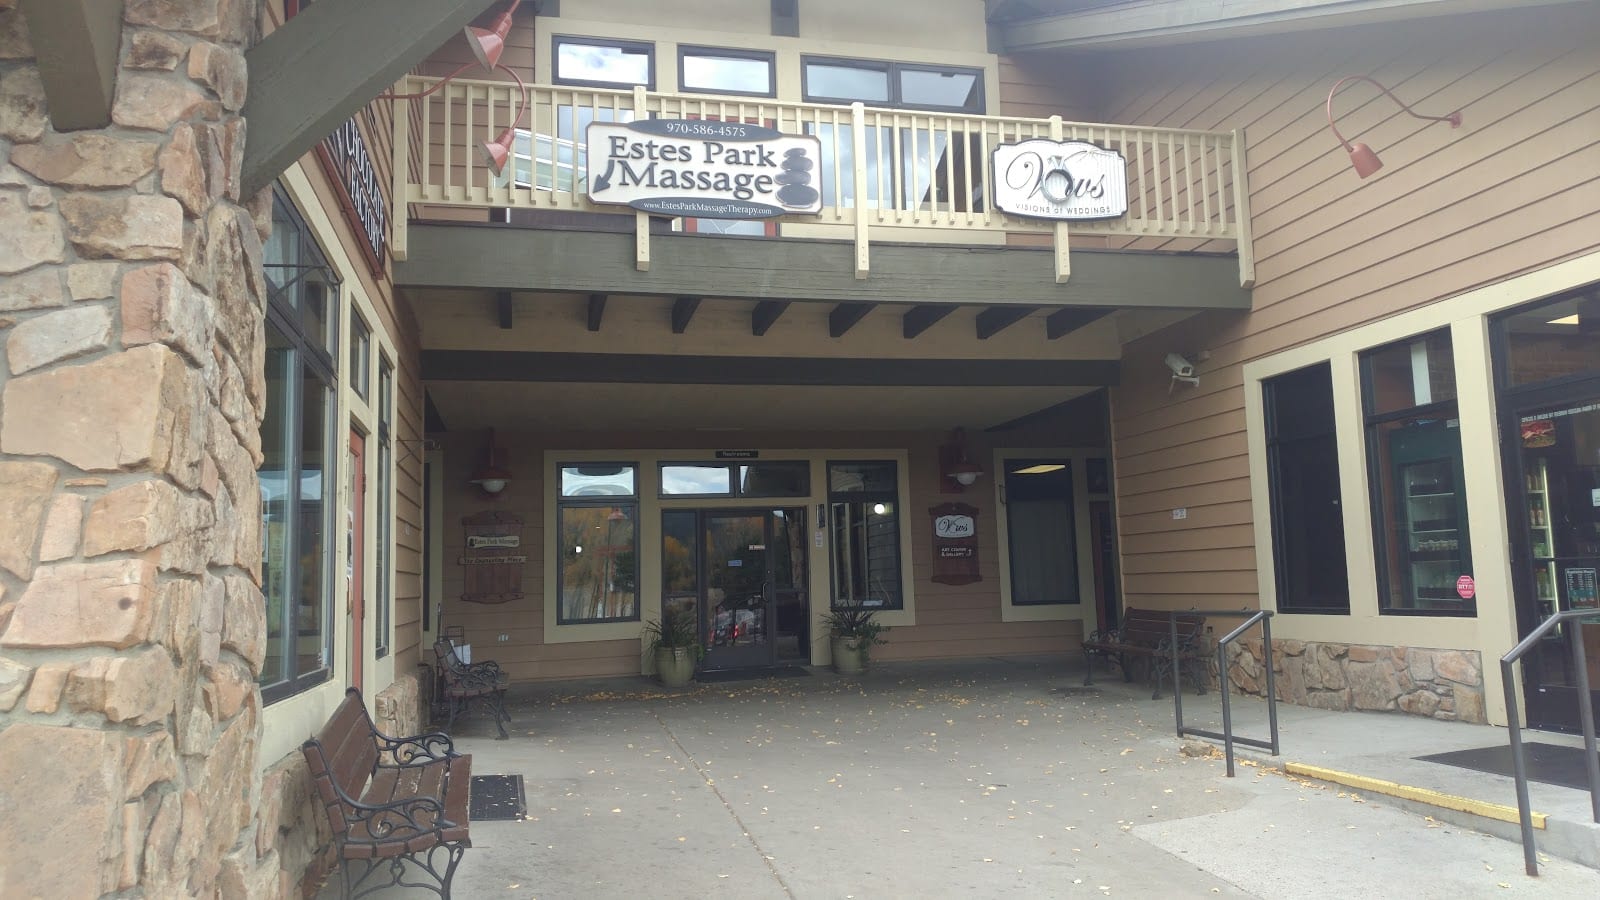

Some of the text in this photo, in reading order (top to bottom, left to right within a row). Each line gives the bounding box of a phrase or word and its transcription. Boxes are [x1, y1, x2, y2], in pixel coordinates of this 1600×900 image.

[666, 122, 746, 137] 970-586-4575
[608, 135, 777, 168] Estes Park
[346, 117, 385, 242] CHOCOLATE
[617, 160, 774, 201] Massage
[350, 162, 380, 258] FACTORY
[643, 200, 772, 216] www.EstesParkMassageTherapy.com
[1015, 203, 1050, 213] VISIONS
[1066, 206, 1111, 215] WEDDINGS
